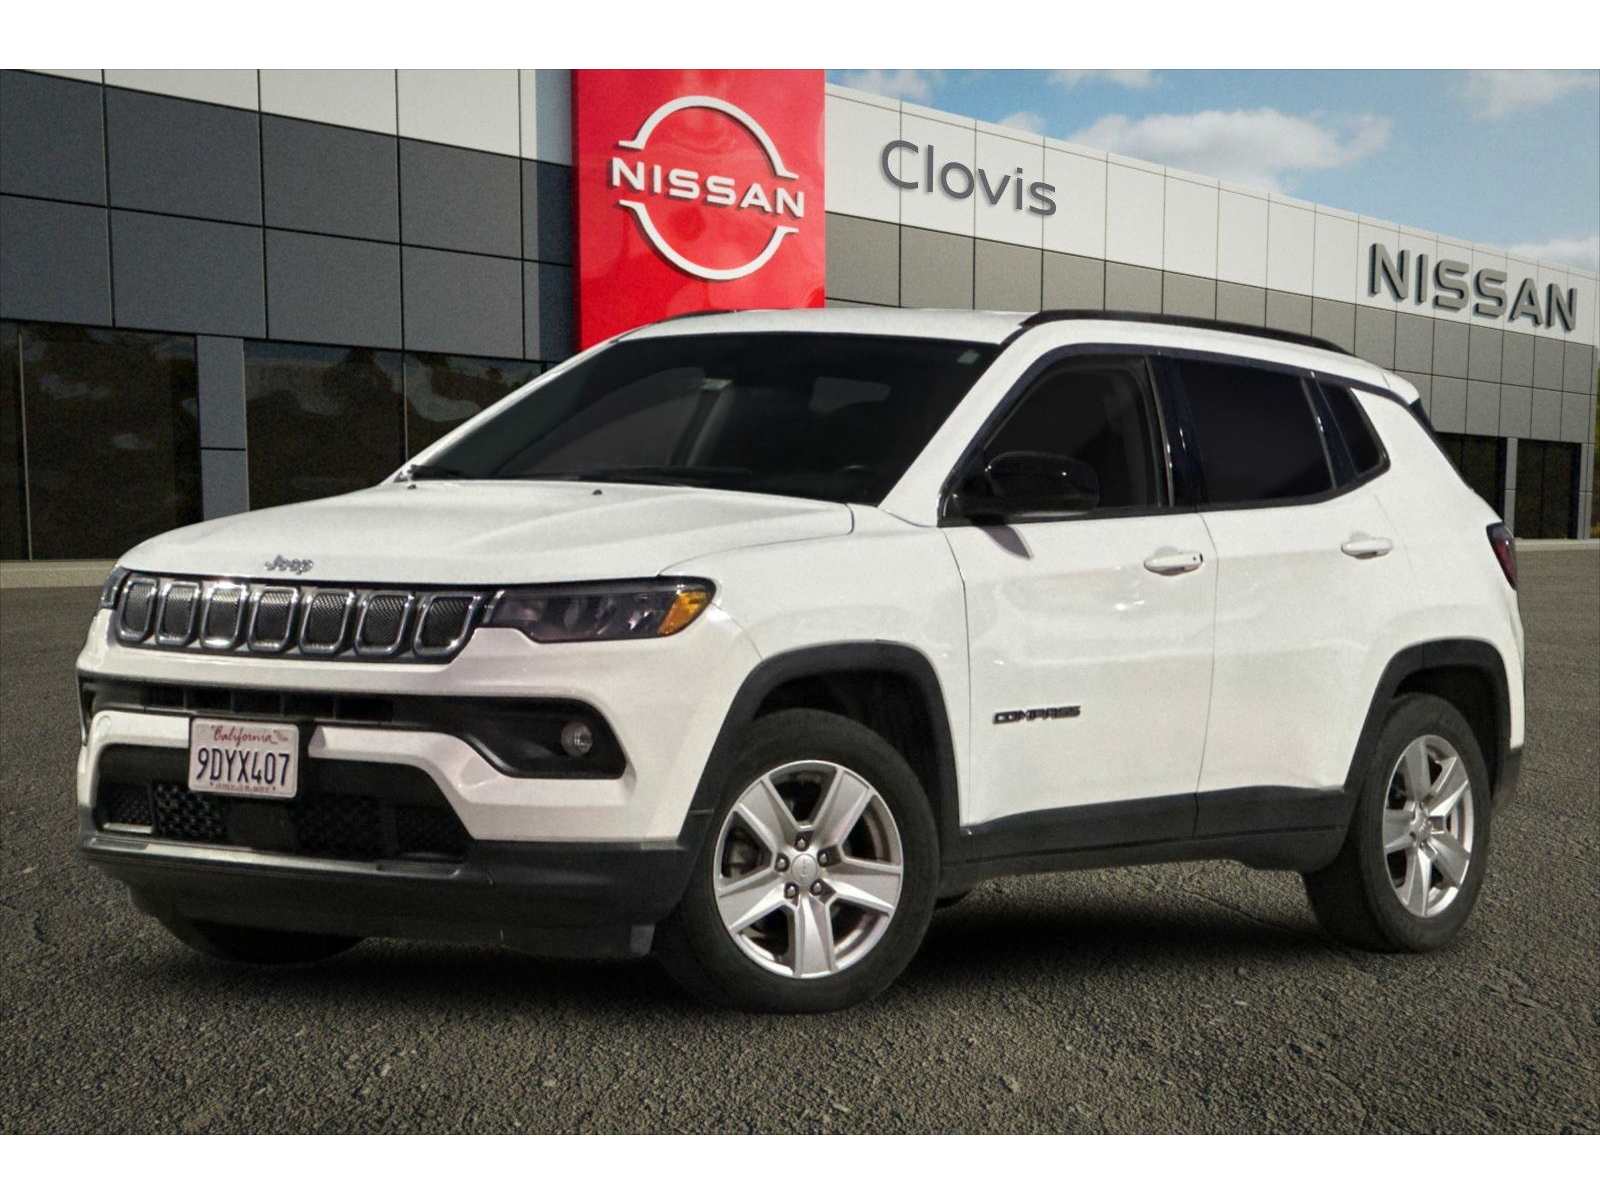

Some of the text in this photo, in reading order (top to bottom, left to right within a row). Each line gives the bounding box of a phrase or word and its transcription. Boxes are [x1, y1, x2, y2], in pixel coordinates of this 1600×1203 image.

[611, 156, 804, 218] NISSAN
[882, 140, 1058, 216] Clovis
[1368, 243, 1578, 332] NISSAN
[196, 747, 290, 787] 9DYX407
[213, 726, 277, 747] California
